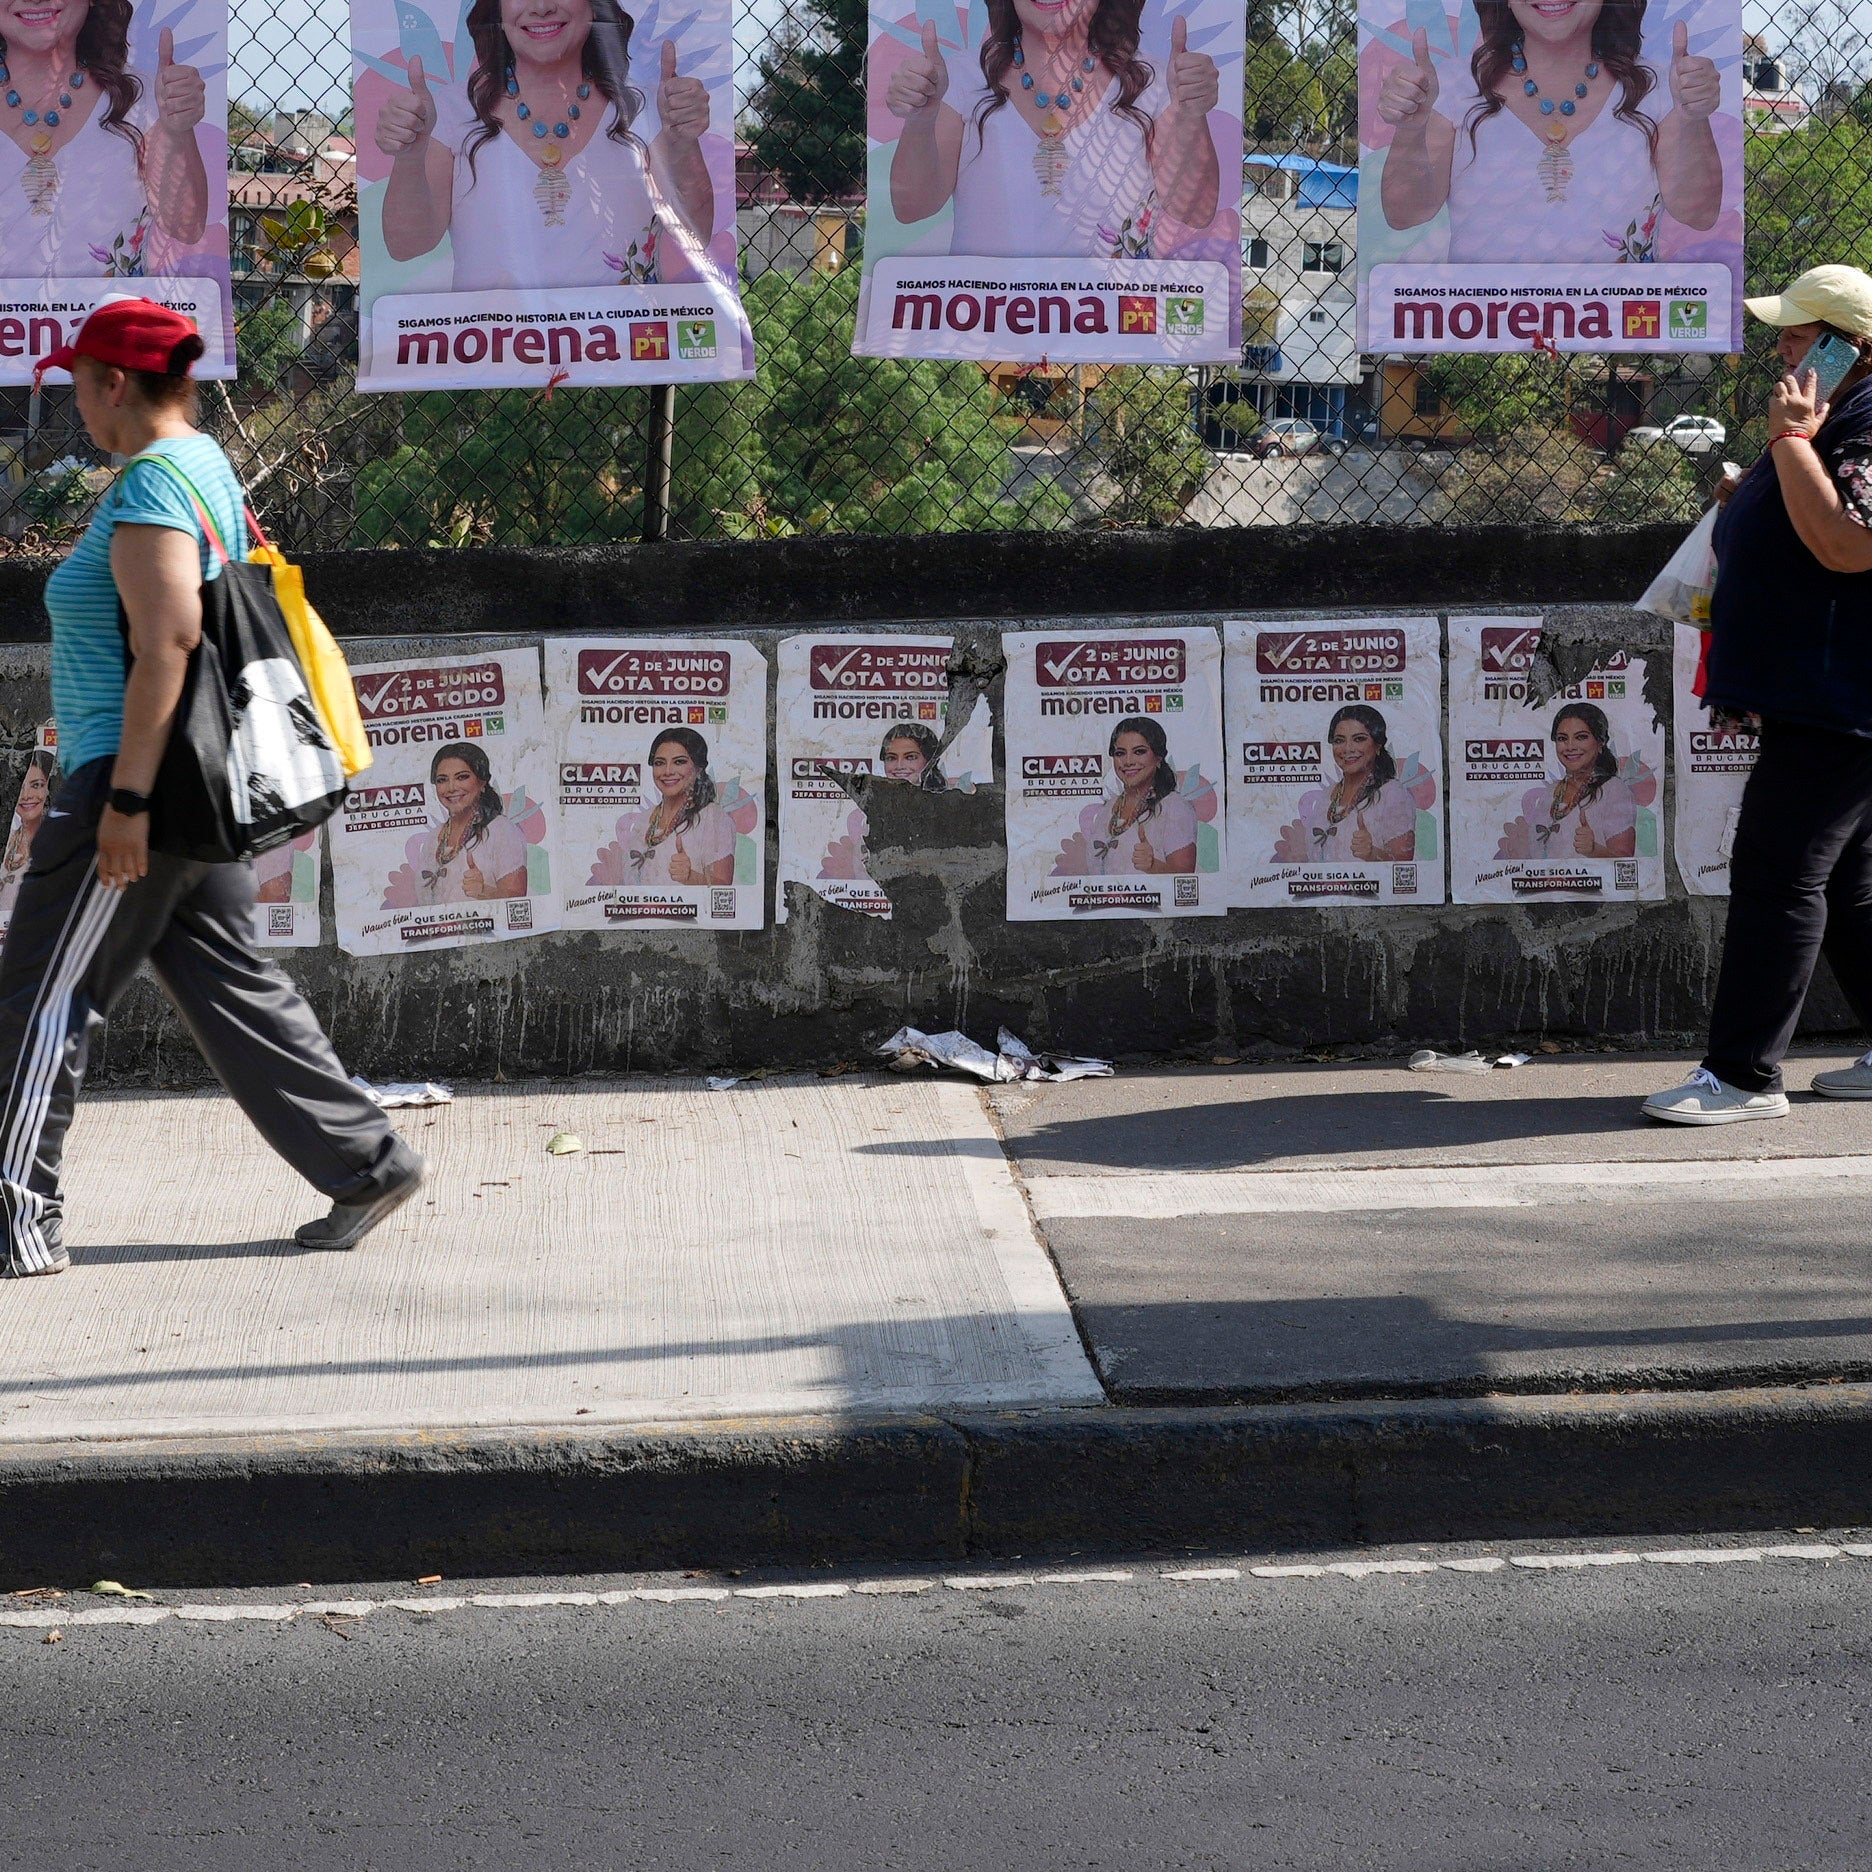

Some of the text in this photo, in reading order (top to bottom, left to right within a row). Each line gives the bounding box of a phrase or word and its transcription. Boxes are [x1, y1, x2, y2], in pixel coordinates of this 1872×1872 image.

[1394, 285, 1708, 297] SIGAMOS HACIENDO HISTORIA EN LA CIUDAD DE MÉXICO
[892, 293, 1108, 334] morena
[1393, 300, 1613, 340] morena
[1626, 315, 1658, 336] PT
[1670, 327, 1707, 339] VERDE
[398, 325, 621, 365] morena
[633, 336, 666, 359] PT
[678, 346, 716, 360] VERDE
[628, 656, 724, 674] 2 DE JUNIO
[659, 674, 724, 693] TODO
[1260, 683, 1361, 703] morena
[580, 703, 683, 726] morena
[1040, 694, 1141, 716] morena
[1245, 745, 1319, 762] CLARA
[1467, 742, 1542, 760] CLARA
[561, 765, 639, 784] CLARA
[1024, 758, 1100, 776] CLARA
[344, 787, 423, 811] CLARA
[1290, 882, 1378, 892] TRANSFORMACIÓN
[606, 905, 696, 916] TRANSFORMACIÓN
[402, 919, 493, 937] TRANSFORMACIÓN
